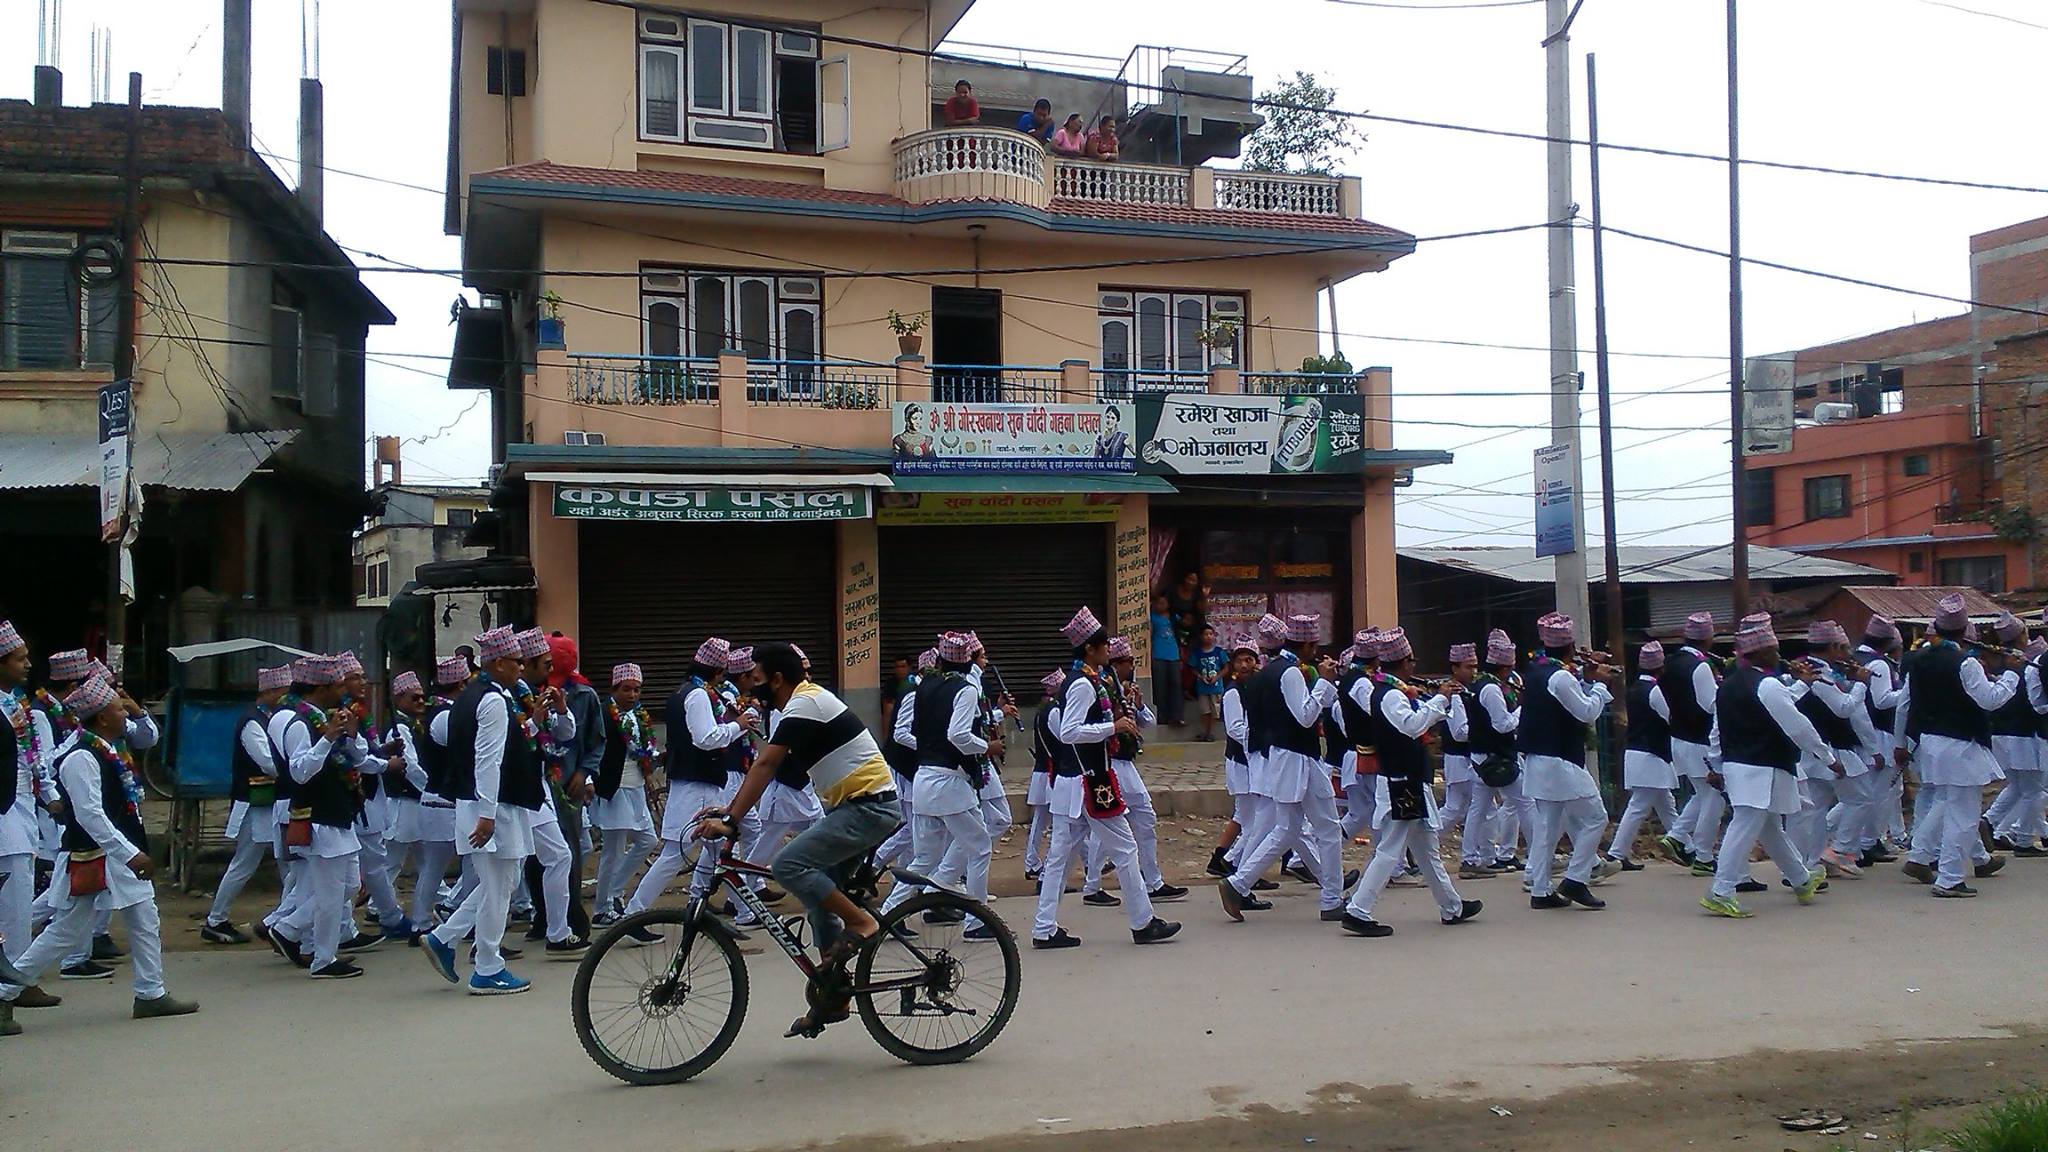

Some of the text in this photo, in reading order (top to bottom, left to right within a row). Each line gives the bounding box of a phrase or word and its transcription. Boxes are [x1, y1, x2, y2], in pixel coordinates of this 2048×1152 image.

[943, 405, 956, 433] श्री
[958, 406, 1005, 433] गोरखनाथ
[1007, 412, 1024, 439] सुन
[1050, 412, 1075, 434] गहना
[1077, 412, 1103, 434] पसल
[1175, 403, 1270, 425] रमेश खाजा
[1212, 427, 1236, 436] तथा
[1277, 417, 1318, 463] TUBORG
[1178, 437, 1269, 457] भोजनालय
[560, 486, 854, 508] कपडा पसल
[943, 496, 972, 510] सुन
[1022, 495, 1064, 507] पसल
